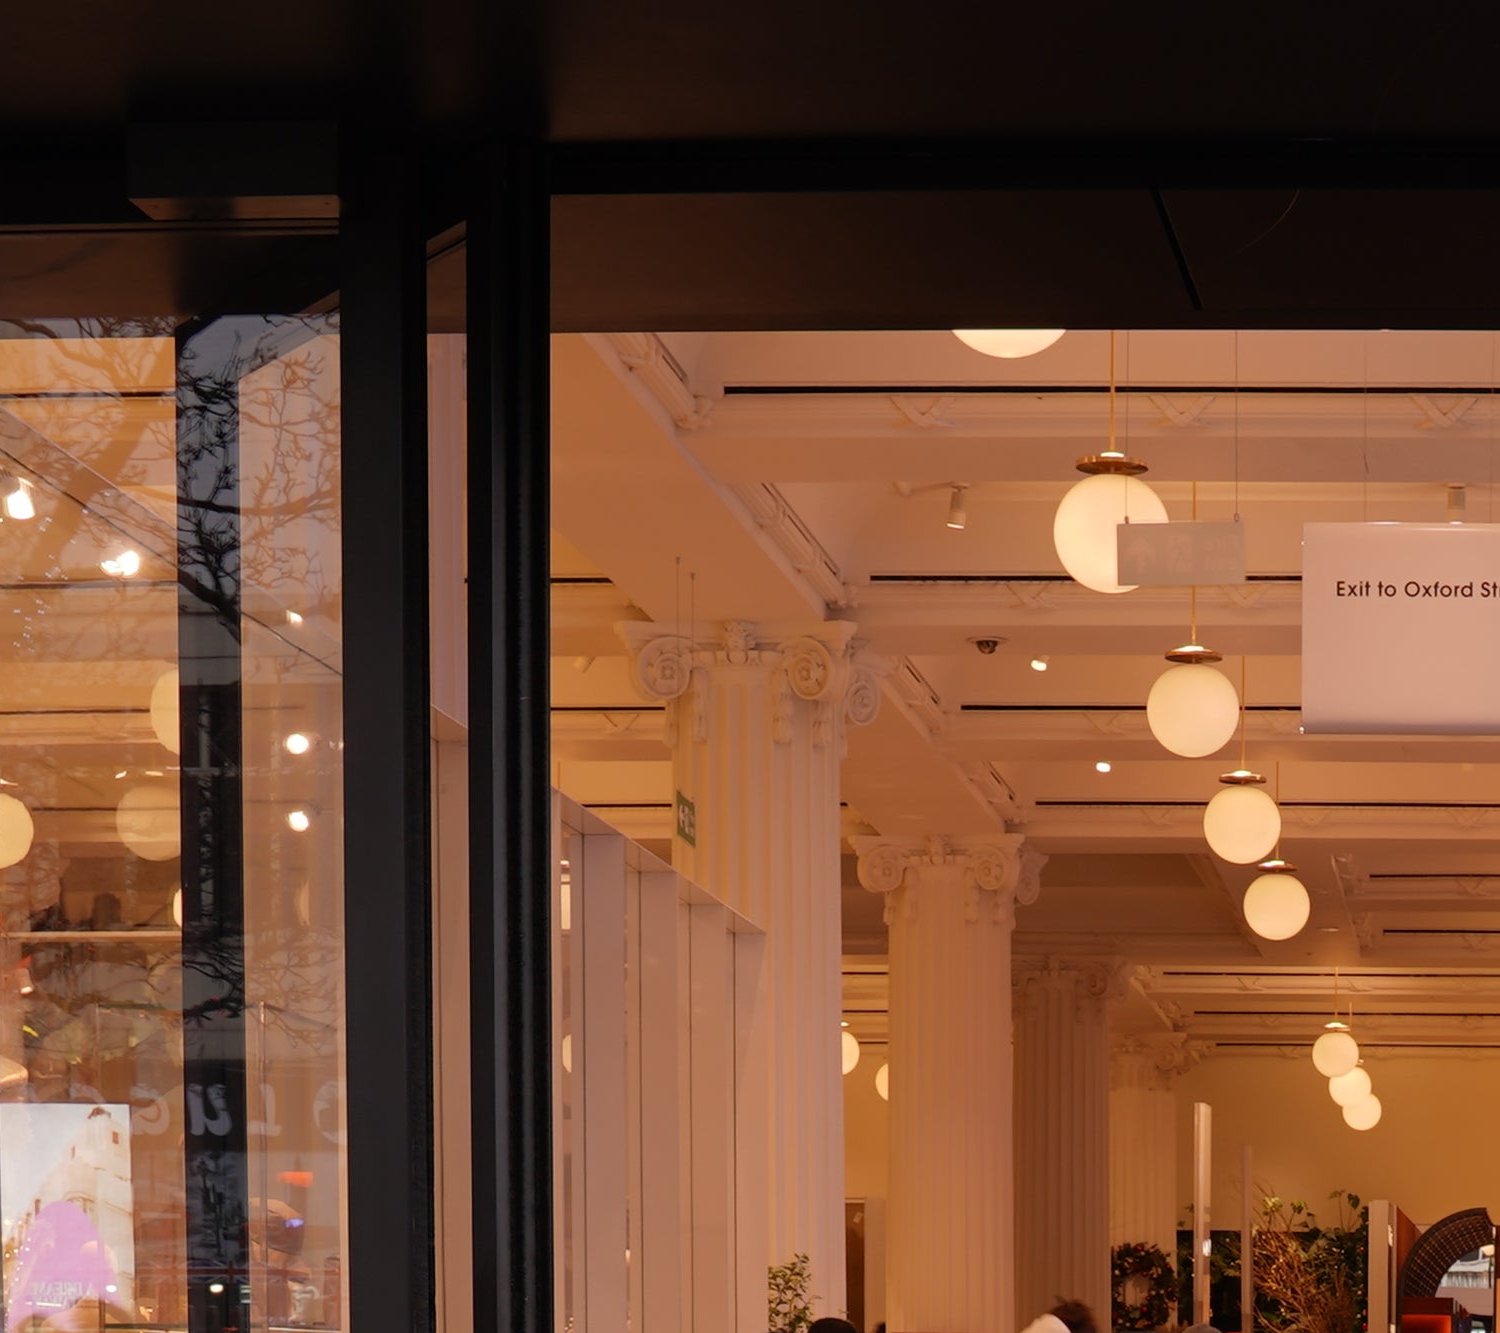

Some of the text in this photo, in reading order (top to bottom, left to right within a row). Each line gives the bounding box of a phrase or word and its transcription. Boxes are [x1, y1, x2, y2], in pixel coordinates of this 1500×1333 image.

[1335, 581, 1370, 598] Exit
[1376, 582, 1397, 598] to
[1403, 581, 1474, 598] Oxford
